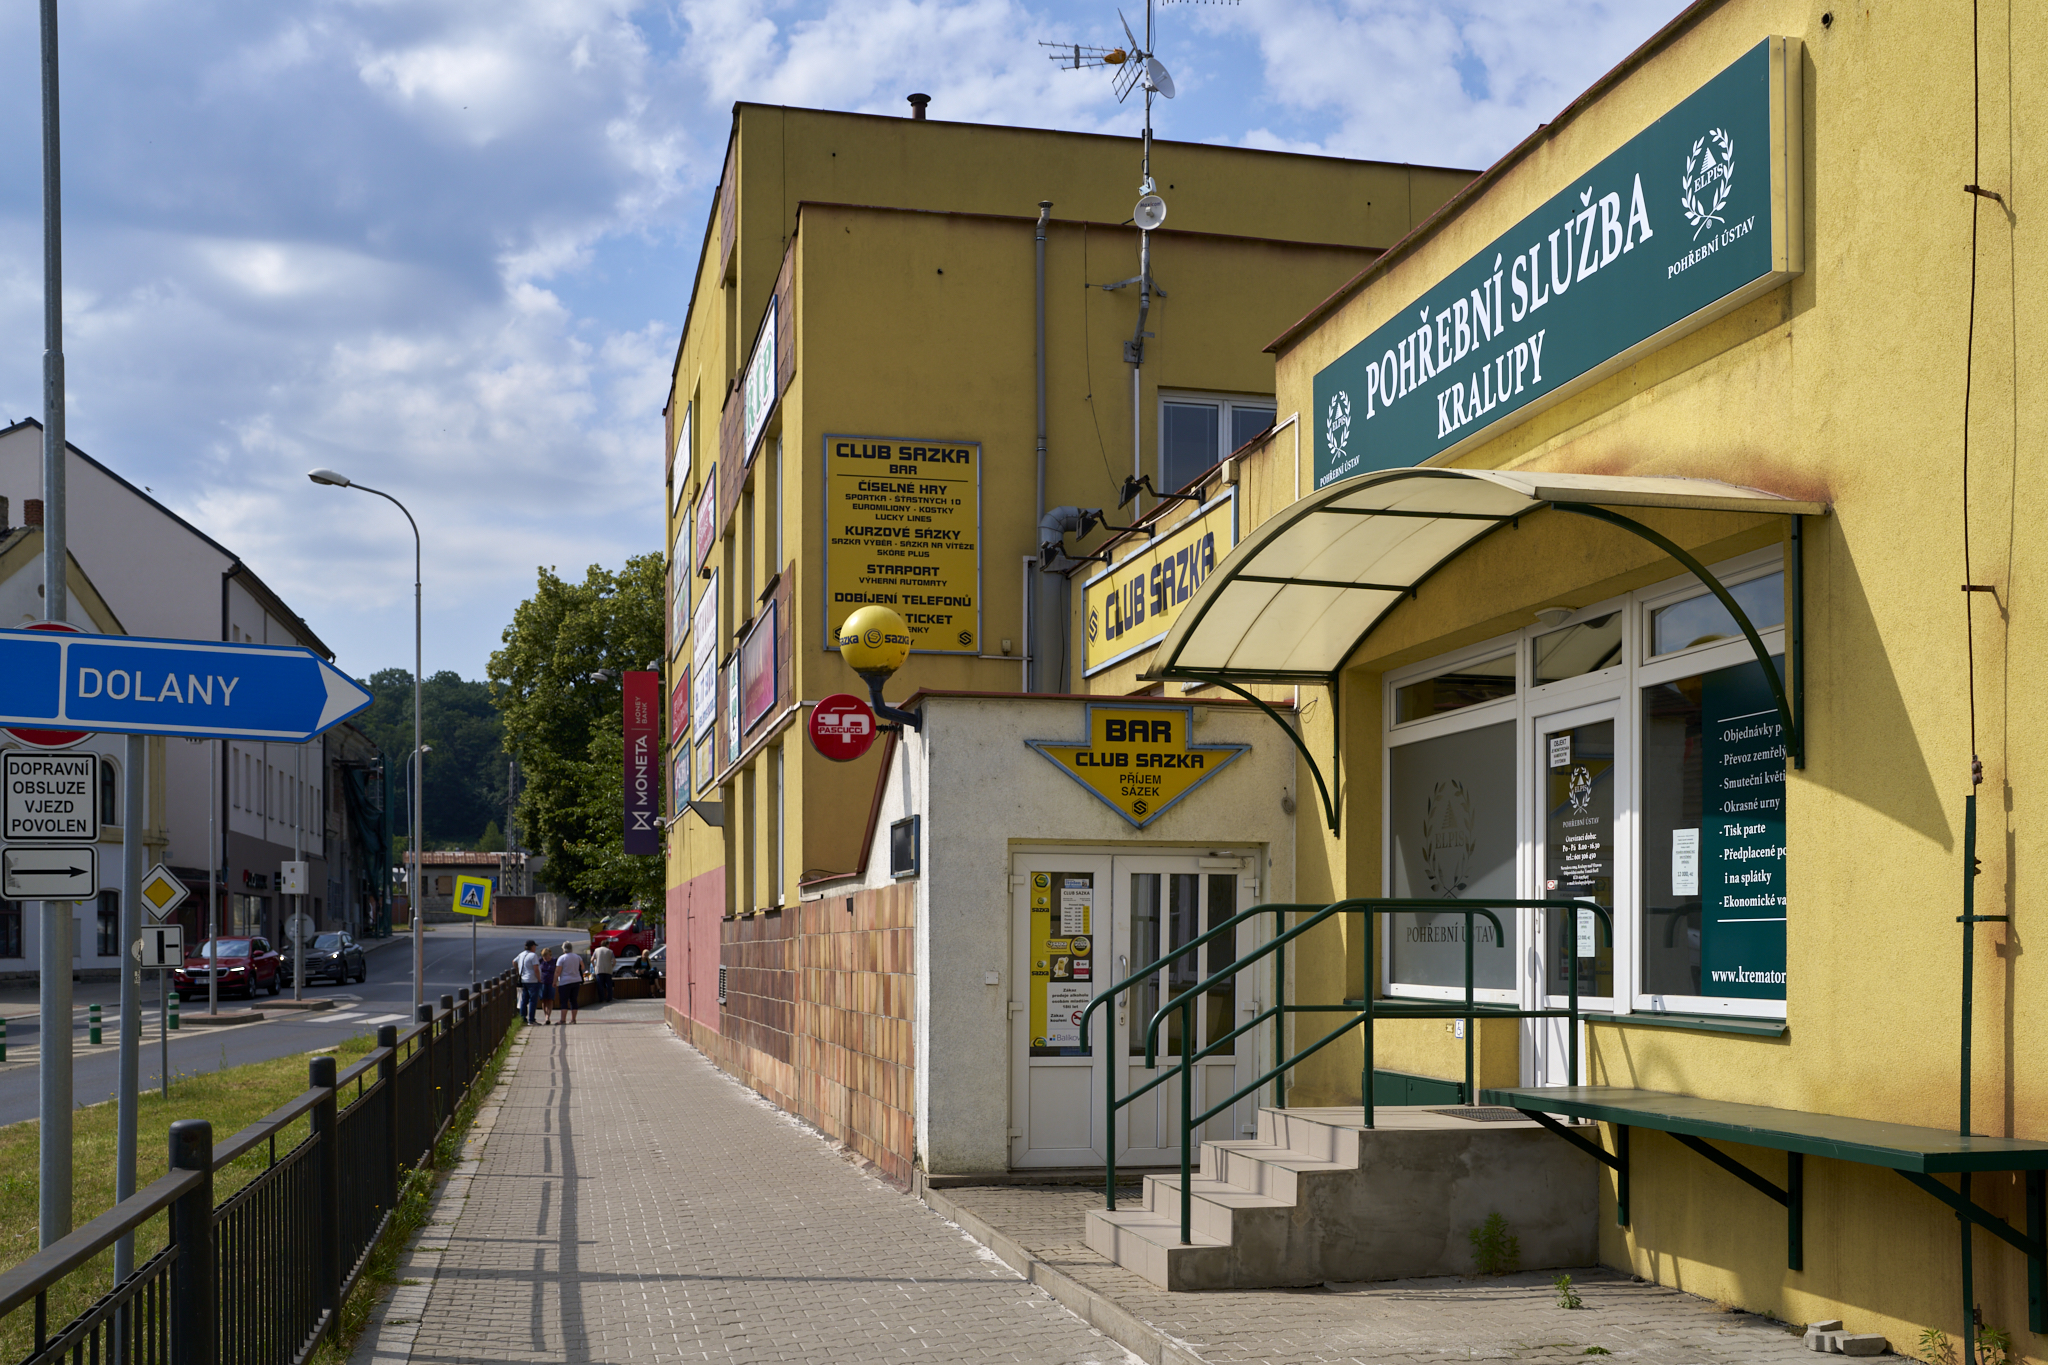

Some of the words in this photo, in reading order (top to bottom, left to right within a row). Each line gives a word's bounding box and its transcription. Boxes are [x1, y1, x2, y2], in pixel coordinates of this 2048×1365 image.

[1693, 162, 1724, 193] ELPIS
[1667, 234, 1719, 279] POHŘEBNÍ
[1721, 215, 1755, 247] ÚSTAV
[1366, 253, 1504, 419] POHŘEBNÍ
[1511, 173, 1653, 322] SLUŽBA
[1437, 329, 1546, 440] KRALUPY
[1332, 415, 1346, 432] ELPIS
[836, 443, 891, 460] CLUB
[899, 446, 970, 464] SAZKA
[889, 464, 917, 475] BAR
[1320, 462, 1345, 487] POHŘEBNÍ
[1344, 454, 1360, 471] ÚSTAV
[858, 479, 915, 493] ČÍSELNÉ
[919, 484, 948, 495] HRY
[845, 493, 887, 502] SPORTKA
[852, 503, 911, 512] EUROMILIONY
[919, 506, 954, 514] KOSTKY
[875, 513, 904, 521] LUCKY
[845, 526, 910, 538] KURZOVÉ
[914, 527, 961, 540] SÁZKY
[866, 564, 940, 576] STARPORT
[859, 576, 897, 585] VÝHERNÍ
[900, 579, 947, 587] AUTOMATY
[1105, 573, 1145, 641] CLUB
[1150, 531, 1214, 617] SAZKA
[834, 591, 897, 604] DOBÍJENÍ
[902, 594, 972, 607] TELEFONŮ
[905, 613, 953, 625] TICKET
[78, 667, 240, 707] DOLANY
[818, 726, 863, 734] PASCUCCI
[1105, 719, 1172, 743] BAR
[1723, 722, 1773, 743] Objednávky
[1775, 723, 1783, 734] p
[1075, 752, 1129, 767] CLUB
[1136, 753, 1204, 768] SAZKA
[1723, 752, 1752, 766] Převoz
[9, 760, 89, 776] DOPRAVNÍ
[635, 735, 648, 806] MONETA
[1120, 772, 1161, 784] PŘÍJEM
[1723, 772, 1763, 790] Smuteční
[12, 781, 86, 795] OBSLUZE
[1121, 784, 1160, 797] SÁZEK
[24, 800, 74, 814] VJEZD
[1723, 797, 1758, 813] Okrasné
[1760, 798, 1780, 811] urny
[12, 819, 87, 832] POVOLEN
[1562, 817, 1585, 828] POHŘEBNÍ
[1723, 823, 1742, 837] Tisk
[1743, 823, 1766, 838] parte
[1435, 830, 1465, 850] ELPIS
[1723, 844, 1776, 863] Předplacené
[1724, 872, 1728, 884] i
[1729, 873, 1740, 884] na
[1740, 869, 1772, 887] splátky
[1723, 893, 1775, 908] Ekonomické
[1406, 922, 1458, 943] POHŘEBNÍ
[1711, 965, 1787, 984] www.kremator
